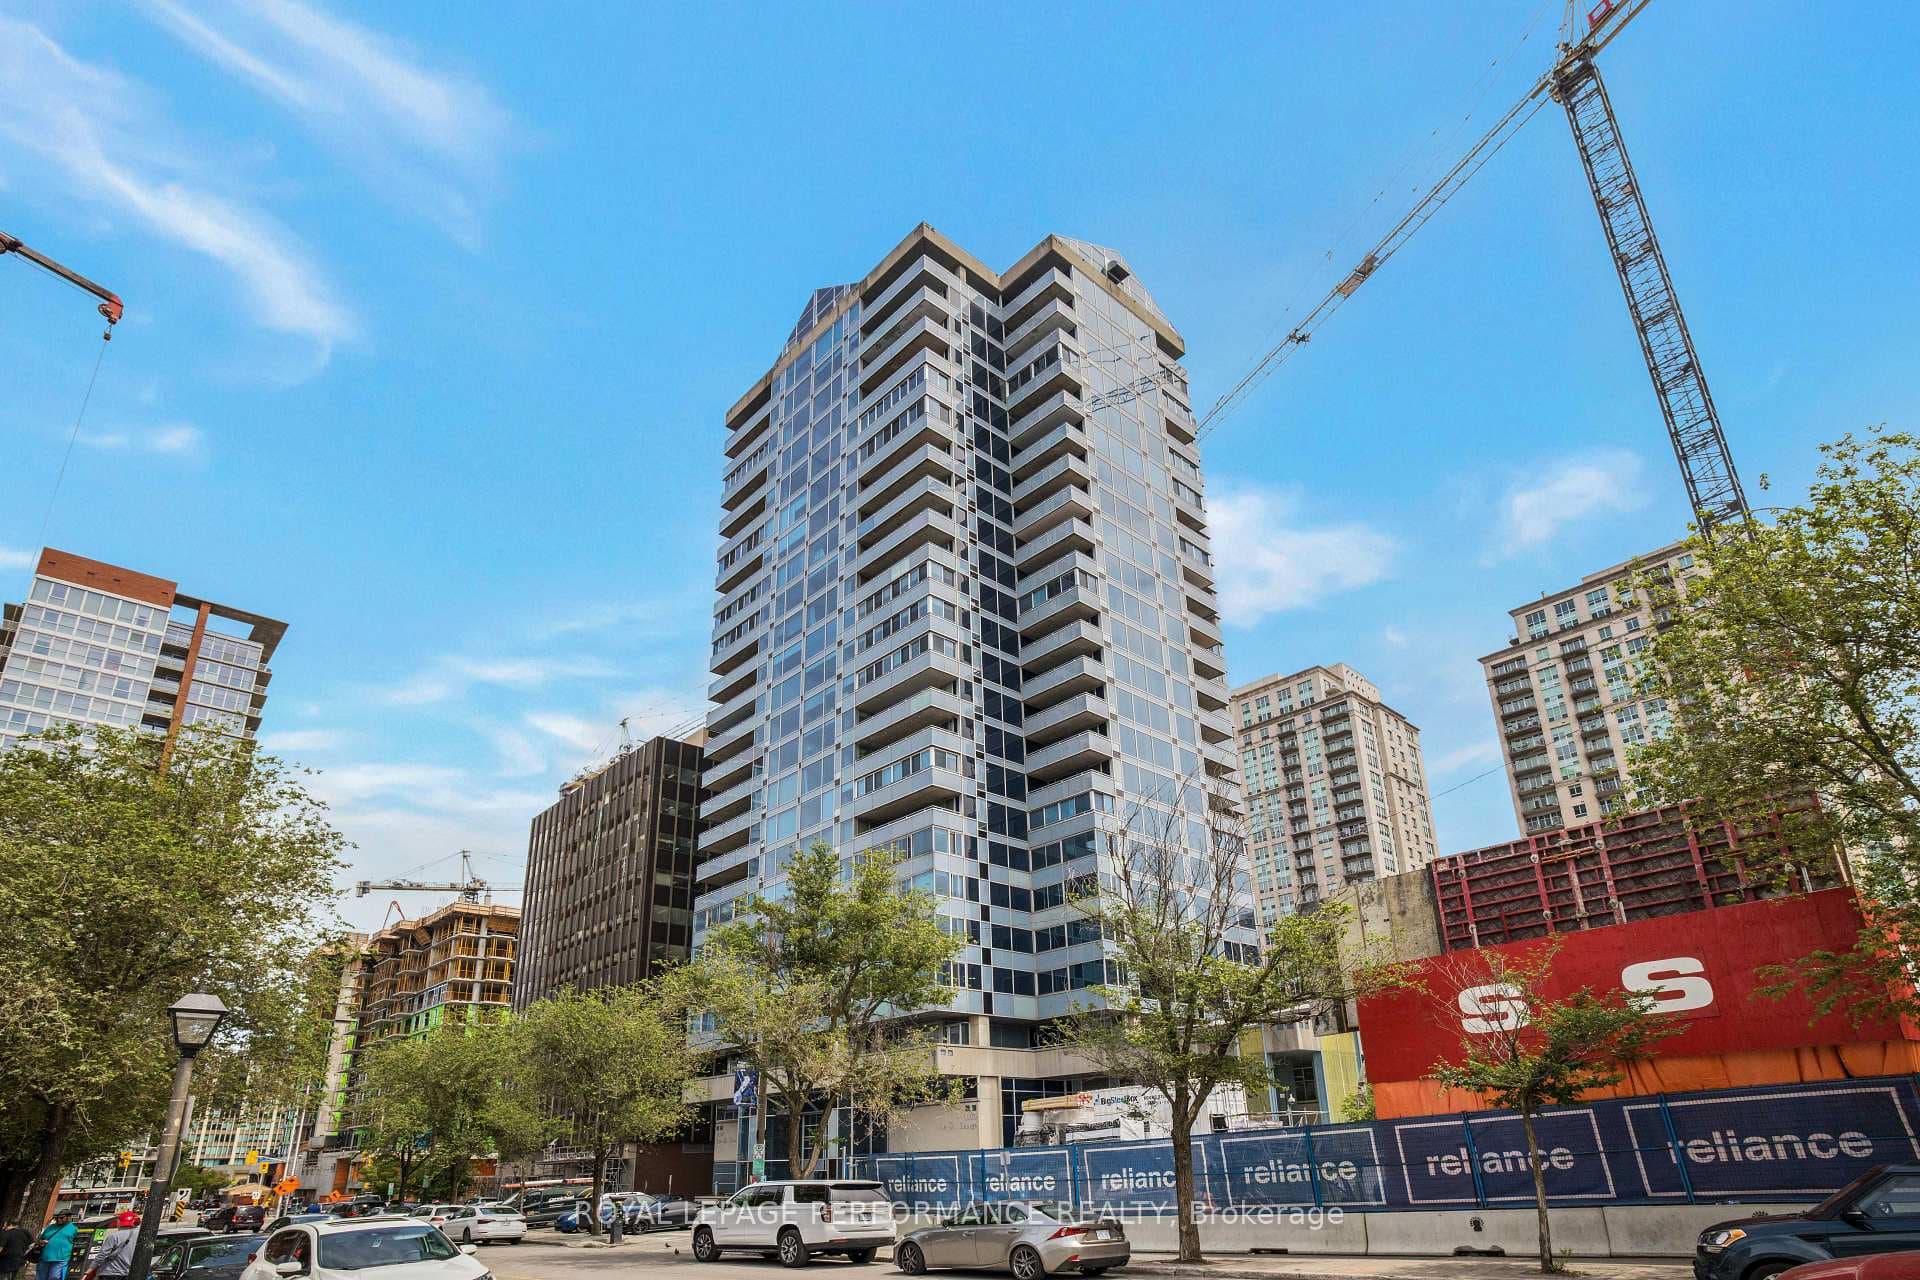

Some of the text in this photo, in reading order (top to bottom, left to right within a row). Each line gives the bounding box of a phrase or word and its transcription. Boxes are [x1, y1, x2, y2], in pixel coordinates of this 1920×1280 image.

[1621, 957, 1714, 1015] S
[1458, 983, 1532, 1034] S
[1667, 1129, 1874, 1164] reliance
[1425, 1147, 1575, 1176] relance
[888, 1174, 947, 1193] reliance
[985, 1173, 1056, 1192] reliance
[1101, 1168, 1177, 1190] relianc
